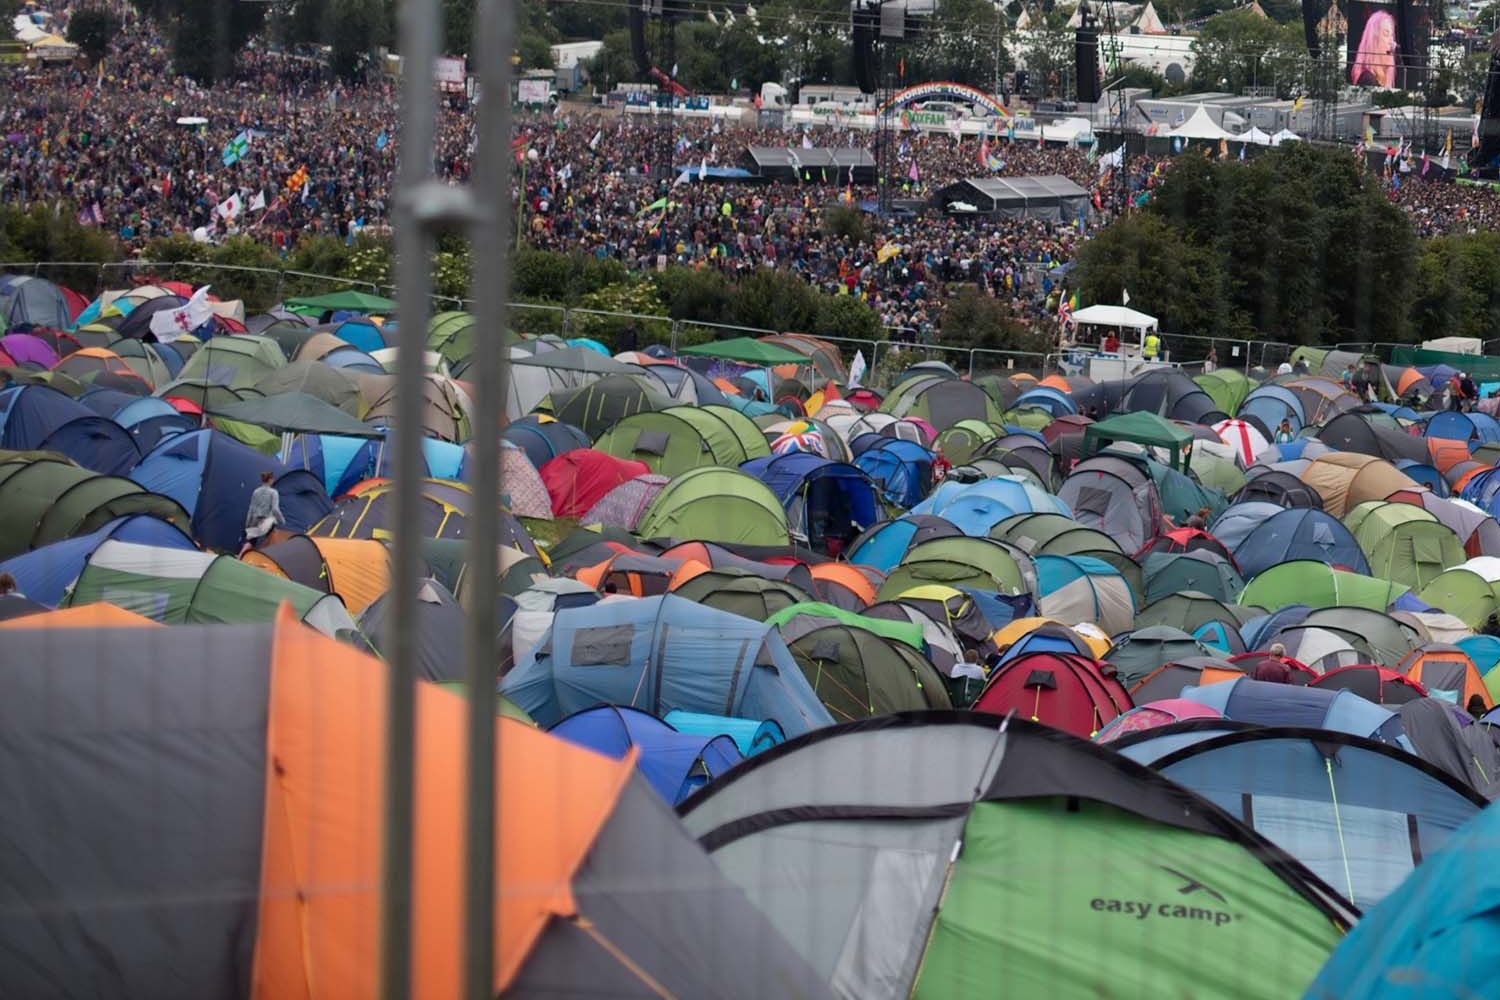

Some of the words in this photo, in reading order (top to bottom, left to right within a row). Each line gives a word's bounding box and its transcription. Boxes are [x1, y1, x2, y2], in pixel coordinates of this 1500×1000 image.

[895, 85, 942, 104] WORKING
[947, 85, 995, 111] TOGETHER
[912, 112, 945, 125] OXFAM
[1090, 897, 1152, 919] easy
[1157, 902, 1232, 927] camp
